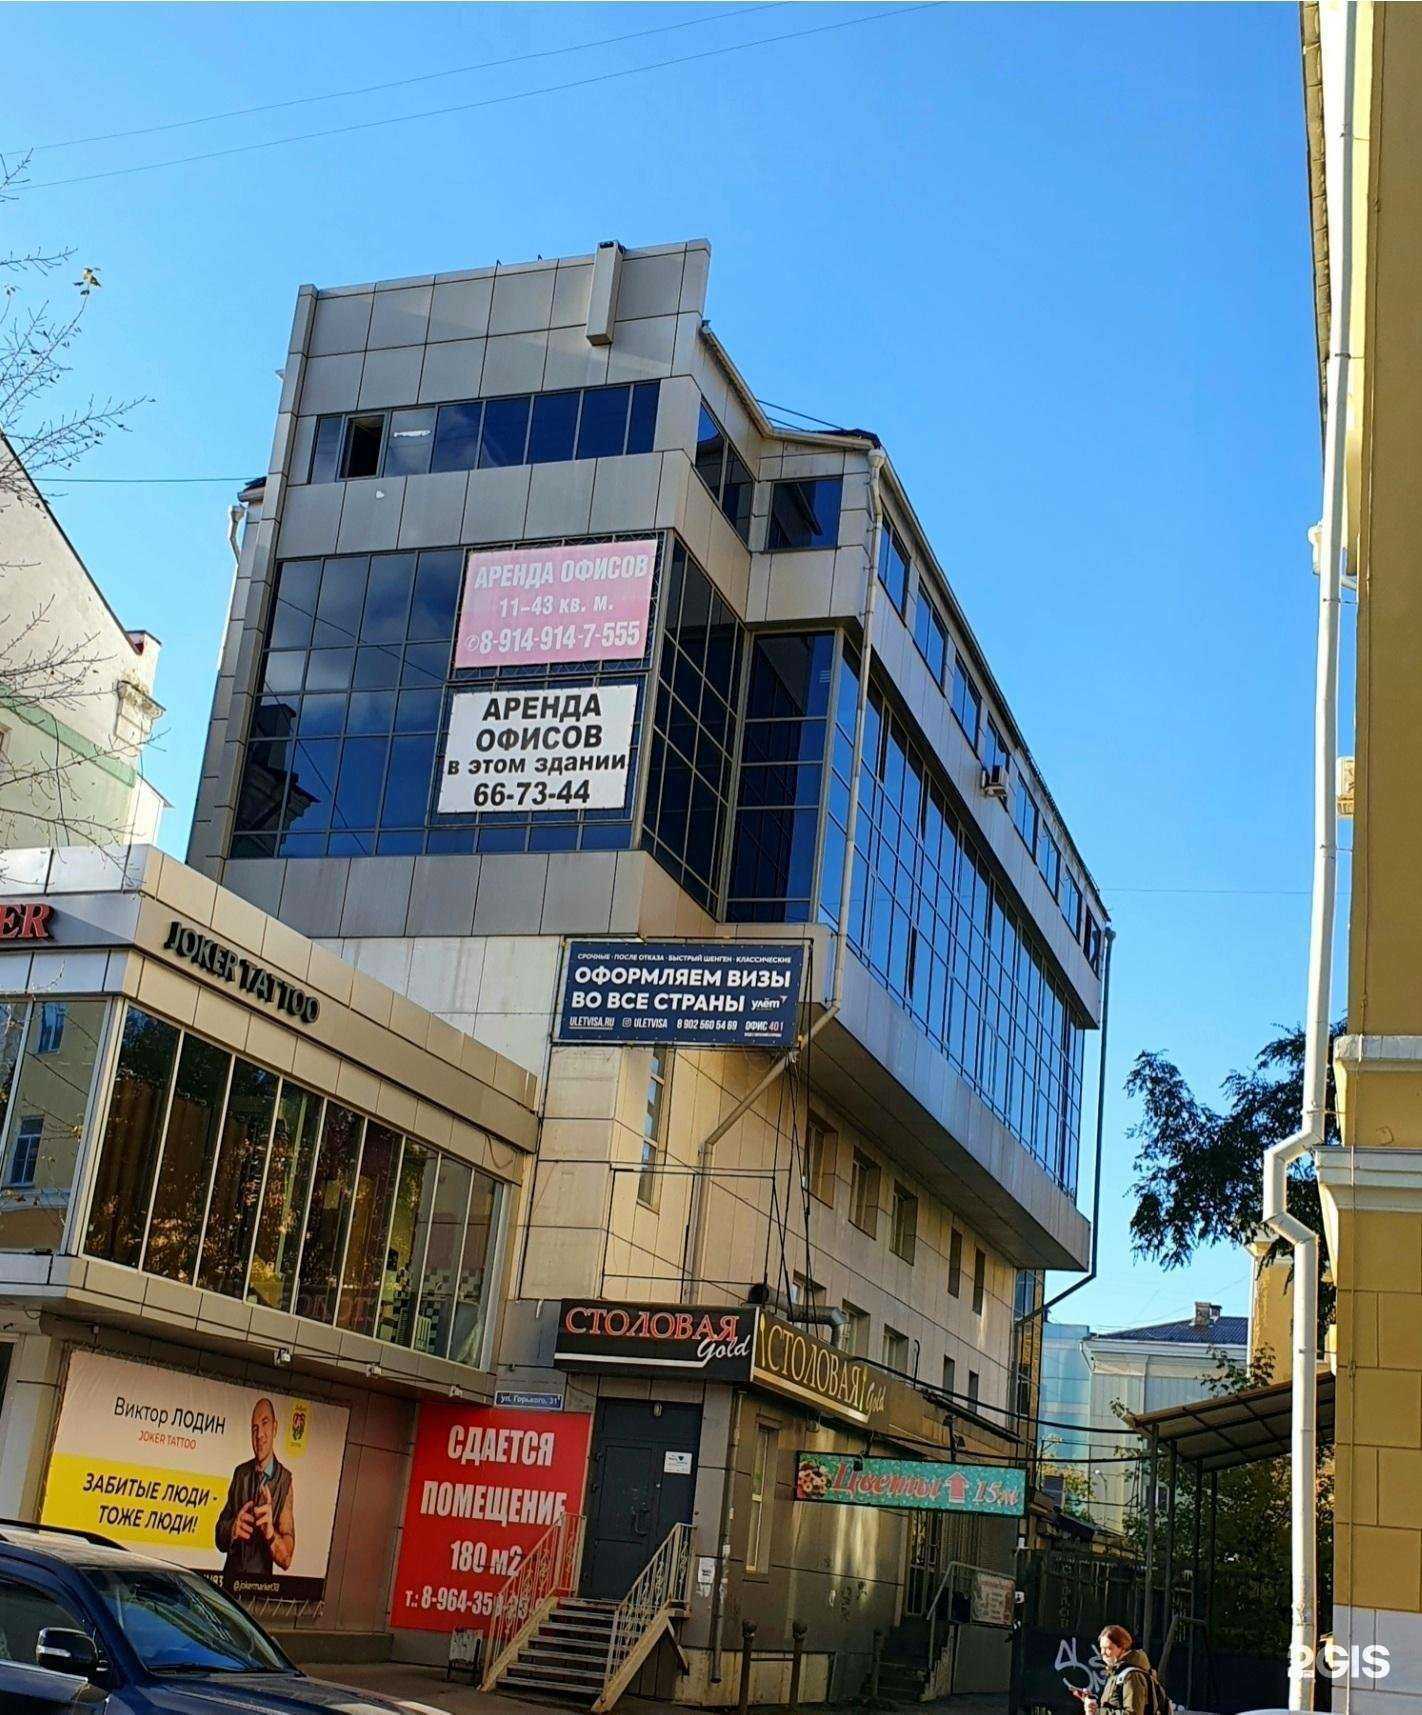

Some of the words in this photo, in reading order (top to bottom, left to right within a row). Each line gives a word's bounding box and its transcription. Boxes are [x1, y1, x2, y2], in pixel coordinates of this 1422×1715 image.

[475, 562, 553, 589] АРЕНДА
[561, 555, 649, 583] ОФИСОВ
[559, 600, 585, 614] кв.
[593, 596, 612, 612] м.
[479, 621, 640, 653] 8-914-914-7-555
[482, 693, 602, 722] АРЕНДА
[476, 725, 602, 751] ОФИСОВ
[448, 760, 460, 775] в
[468, 758, 525, 774] этом
[534, 754, 626, 776] здании
[473, 780, 591, 806] 66-73-44
[164, 921, 238, 982] JOKER
[239, 959, 320, 1023] TATTOO
[668, 954, 702, 962] БЫСТРЫЙ
[704, 955, 732, 963] ШЕНГЕН
[736, 956, 791, 964] КЛАССИЧЕСКИЕ
[574, 966, 721, 987] ОФОРМЛЯЕМ
[727, 970, 791, 988] ВИЗЫ
[571, 991, 601, 1009] ВО
[606, 992, 649, 1010] ВСЕ
[653, 993, 745, 1012] СТРАНЫ
[751, 998, 781, 1010] улёт
[569, 1016, 615, 1027] ULETVISA.RU
[633, 1018, 668, 1029] ULETVISA
[676, 1019, 683, 1029] 8
[684, 1019, 698, 1029] 902
[745, 1021, 768, 1031] ОФИС
[769, 1021, 784, 1032] 401
[565, 1306, 739, 1342] СТОЛОВАЯ
[697, 1334, 750, 1359] Gold
[768, 1325, 861, 1408] СТОЛОВАЯ
[114, 1396, 168, 1426] Виктор
[171, 1408, 226, 1434] ЛОДИН
[138, 1430, 165, 1445] JOKER
[165, 1432, 197, 1450] TATTOO
[447, 1424, 555, 1467] СДАЕТСЯ
[83, 1472, 160, 1500] ЗАБИТЫЕ
[162, 1484, 210, 1507] ЛЮДИ
[830, 1459, 943, 1500] Цветы
[420, 1480, 567, 1528] ПОМЕЩЕНИЕ
[99, 1504, 142, 1528] ТОЖЕ
[145, 1511, 198, 1534] ЛЮДИ!
[450, 1540, 486, 1573] 180
